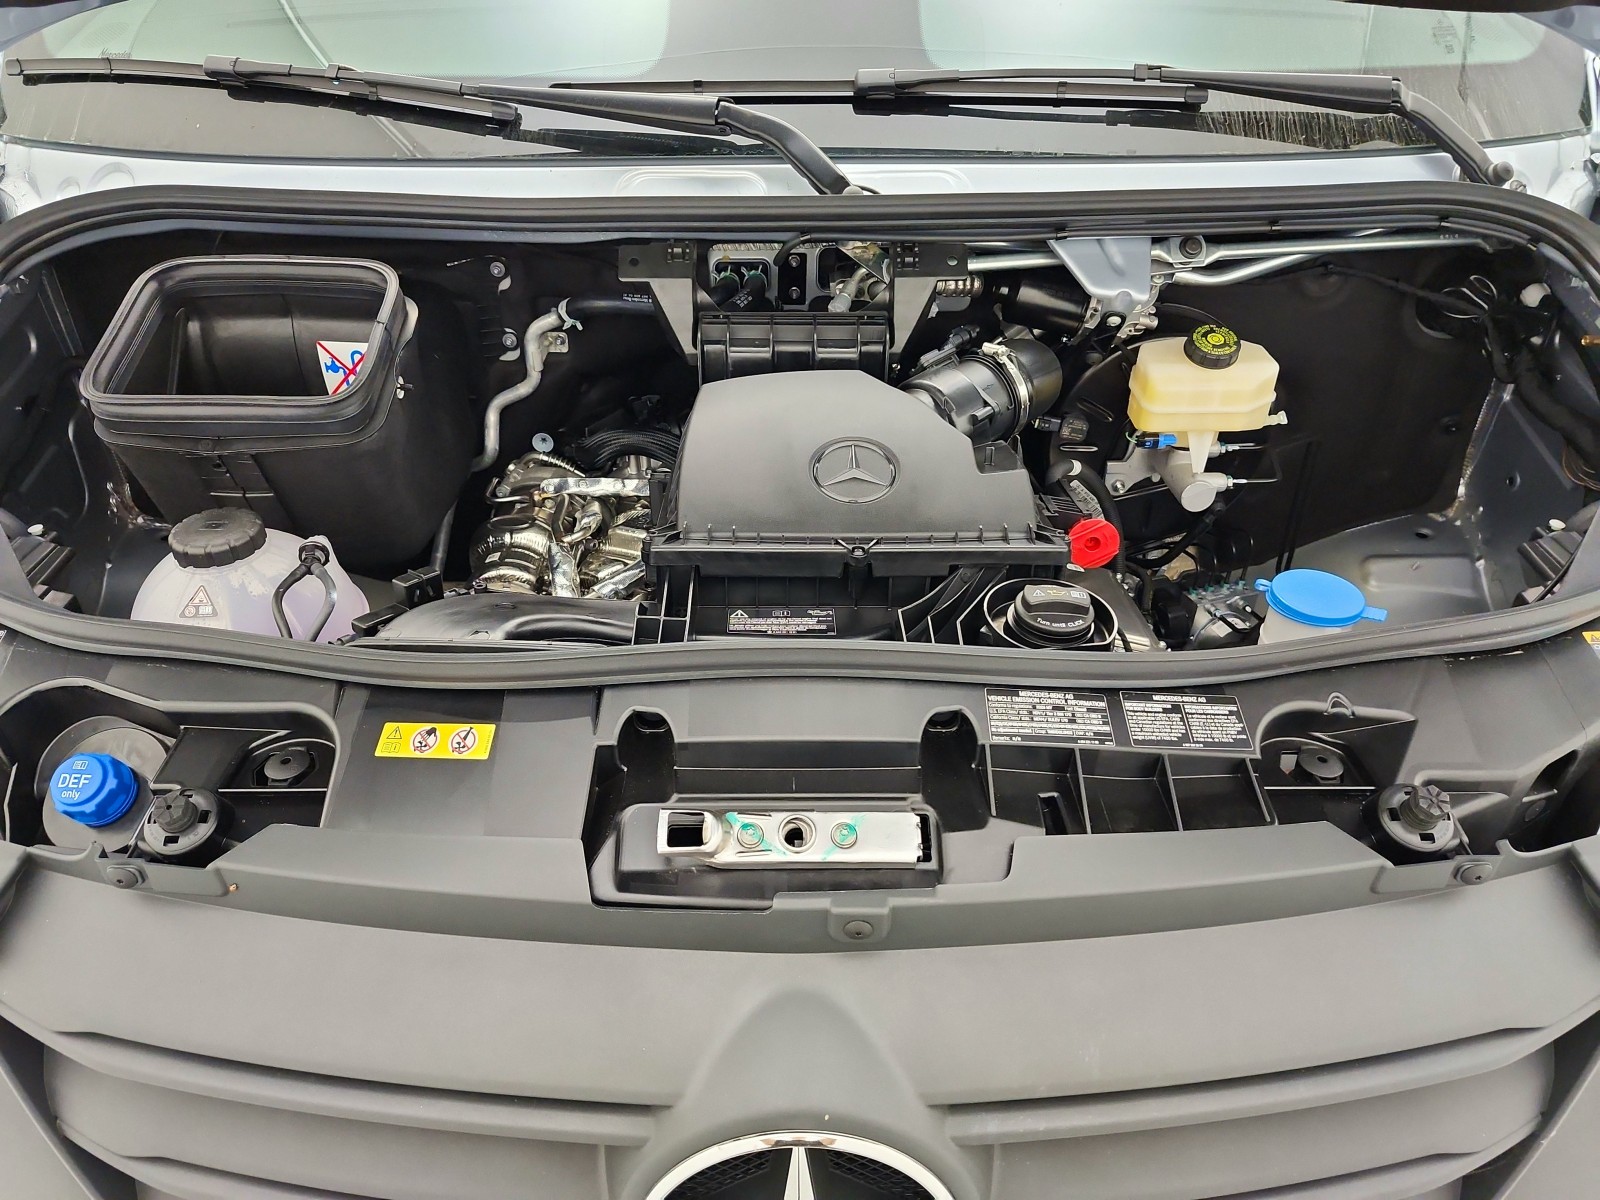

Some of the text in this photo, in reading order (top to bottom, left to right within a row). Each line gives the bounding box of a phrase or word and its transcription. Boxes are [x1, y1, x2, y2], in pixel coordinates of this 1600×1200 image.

[1037, 618, 1050, 626] Turn
[1068, 620, 1085, 628] CLICK
[1018, 690, 1064, 699] MERCEDES-BENZ
[57, 773, 92, 788] DEF
[61, 789, 81, 801] only
